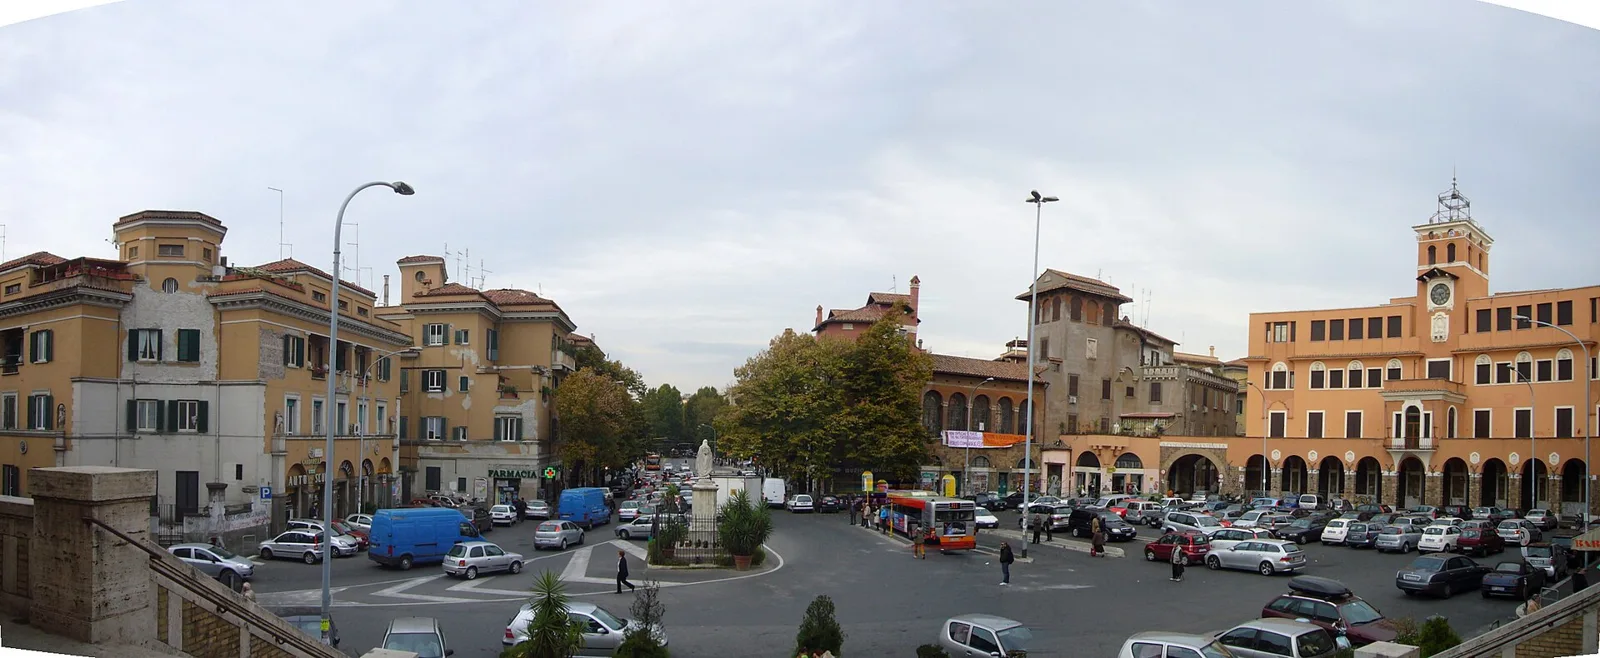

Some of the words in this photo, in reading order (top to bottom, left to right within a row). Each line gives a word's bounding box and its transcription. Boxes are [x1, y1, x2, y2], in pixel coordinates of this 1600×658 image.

[488, 470, 537, 478] FARMACIA
[289, 474, 308, 486] AUTO
[262, 487, 270, 498] P
